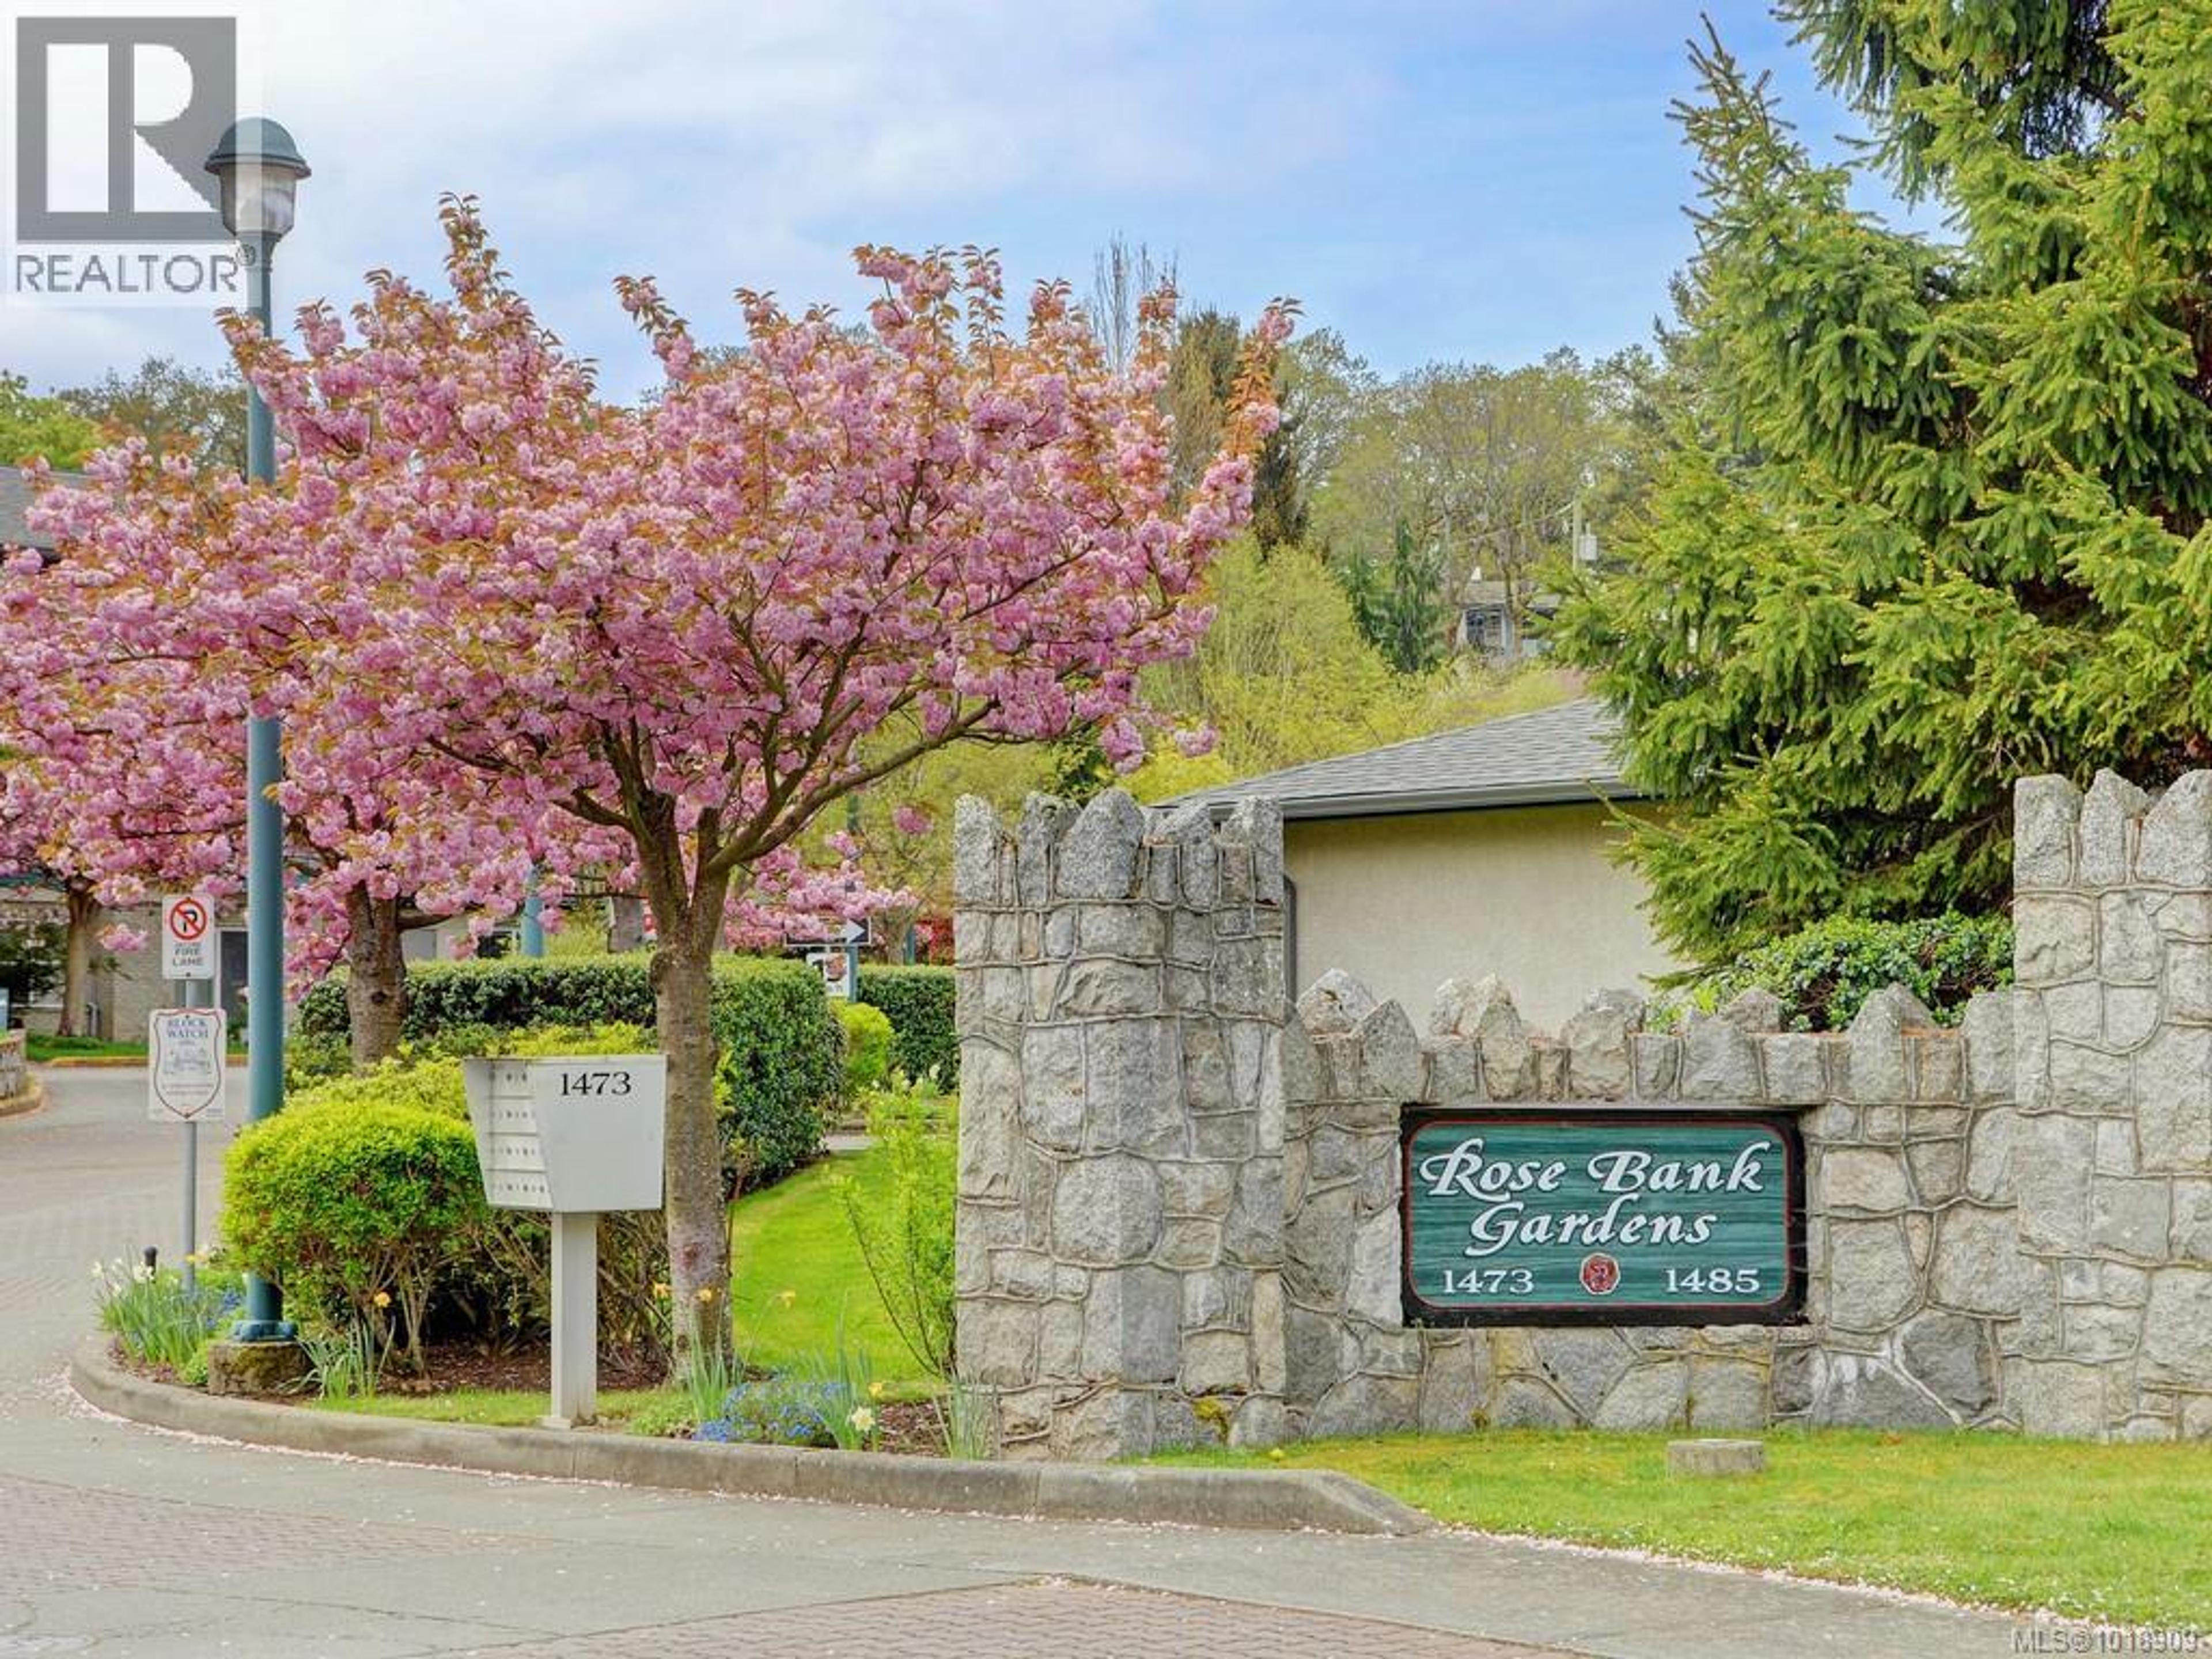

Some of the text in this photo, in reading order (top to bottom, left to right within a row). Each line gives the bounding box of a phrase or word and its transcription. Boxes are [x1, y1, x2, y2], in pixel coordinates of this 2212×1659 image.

[560, 1071, 632, 1095] 1473
[1419, 1138, 1771, 1202] Rose Bank
[1464, 1194, 1718, 1256] Gardens
[1442, 1268, 1534, 1294] 1473
[1666, 1268, 1760, 1293] 1485
